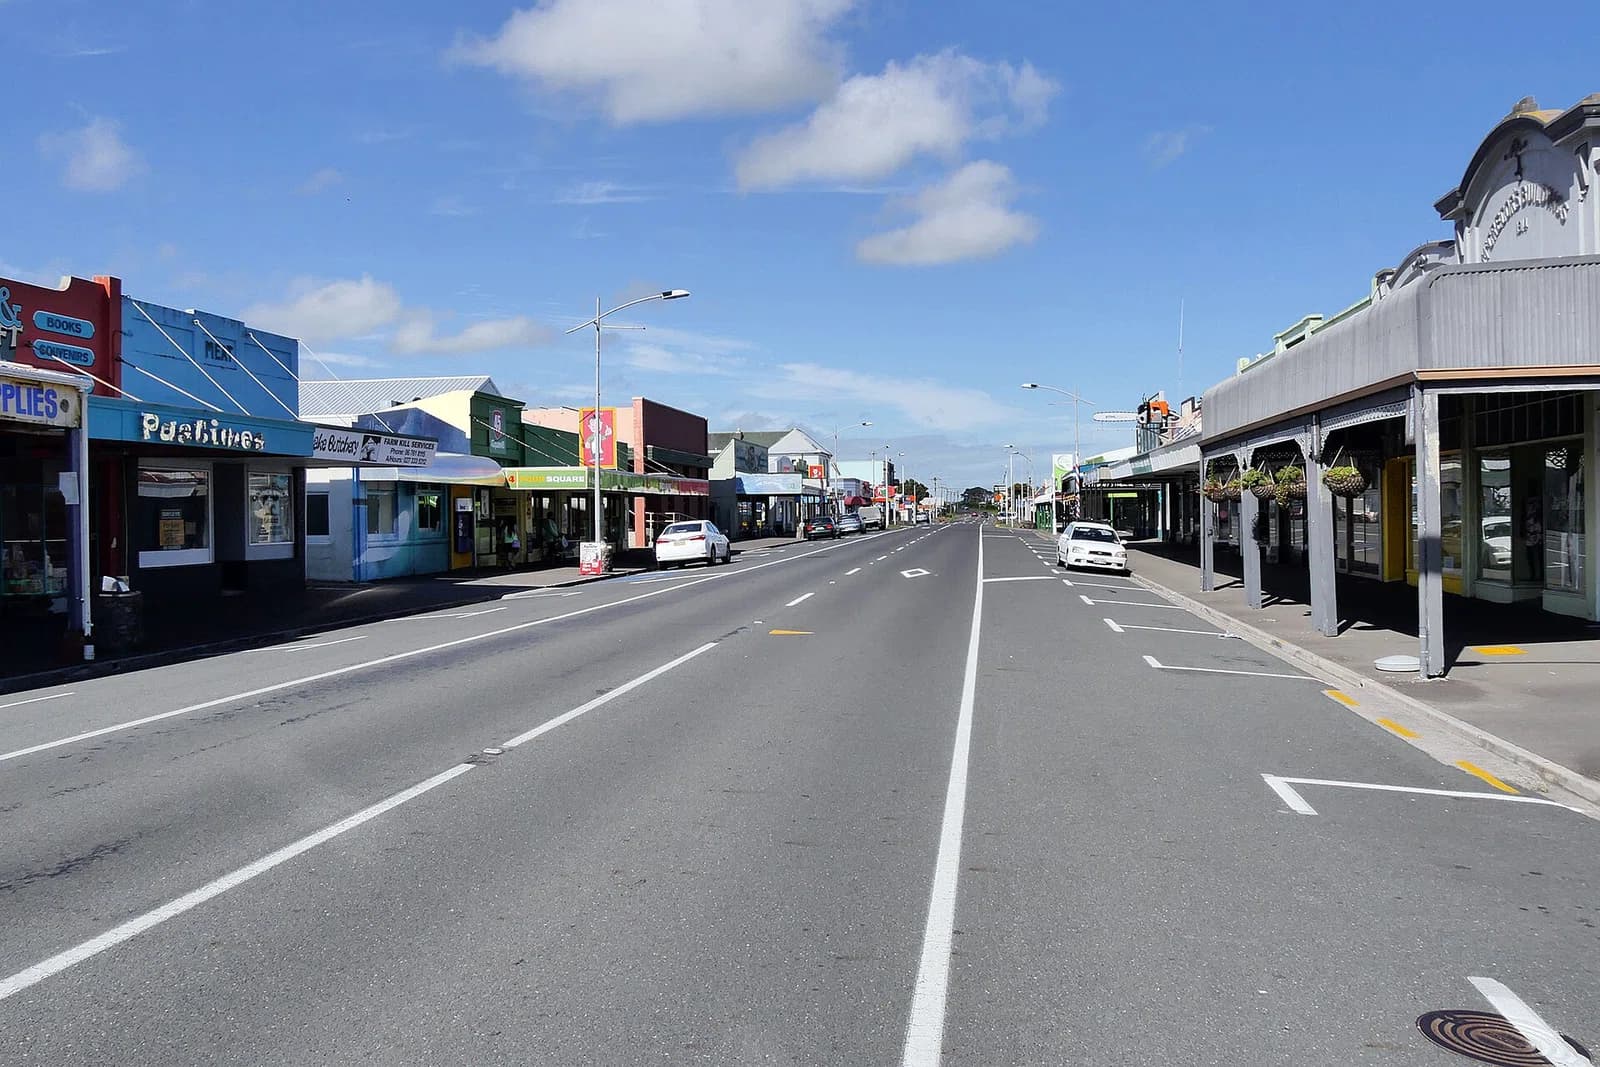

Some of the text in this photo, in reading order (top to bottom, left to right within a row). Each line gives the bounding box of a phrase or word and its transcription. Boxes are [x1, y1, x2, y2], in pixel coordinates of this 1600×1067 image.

[46, 317, 82, 334] BOOKS
[0, 383, 58, 419] PLIES
[327, 434, 359, 456] Butchery
[383, 437, 435, 450] FARM KILL SERVICES
[546, 475, 585, 483] SQUARE
